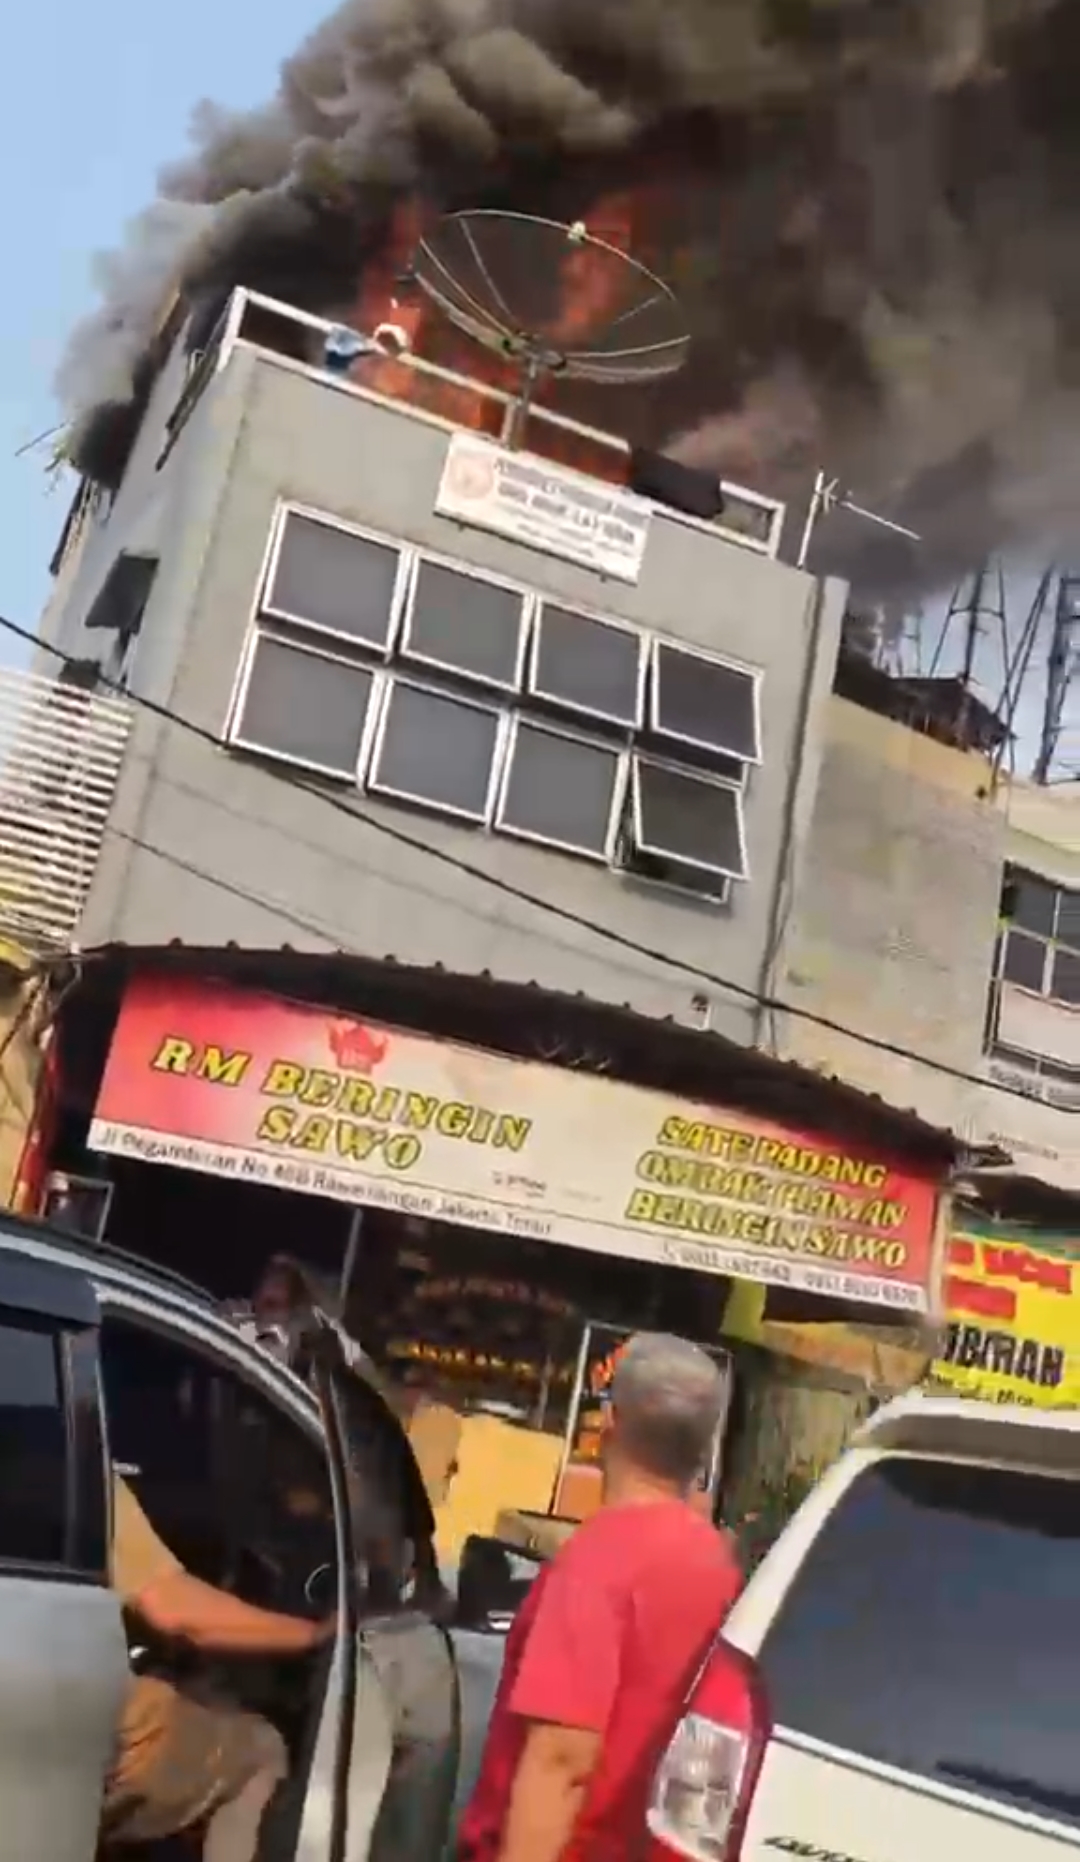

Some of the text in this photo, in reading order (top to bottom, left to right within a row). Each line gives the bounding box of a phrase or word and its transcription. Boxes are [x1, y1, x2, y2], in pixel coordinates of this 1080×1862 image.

[151, 1036, 533, 1152] RM BERINGIN
[257, 1106, 424, 1170] SAWO
[657, 1115, 888, 1189] SATE PADANG
[625, 1188, 802, 1251] BERINGIN
[804, 1225, 908, 1270] SAWO
